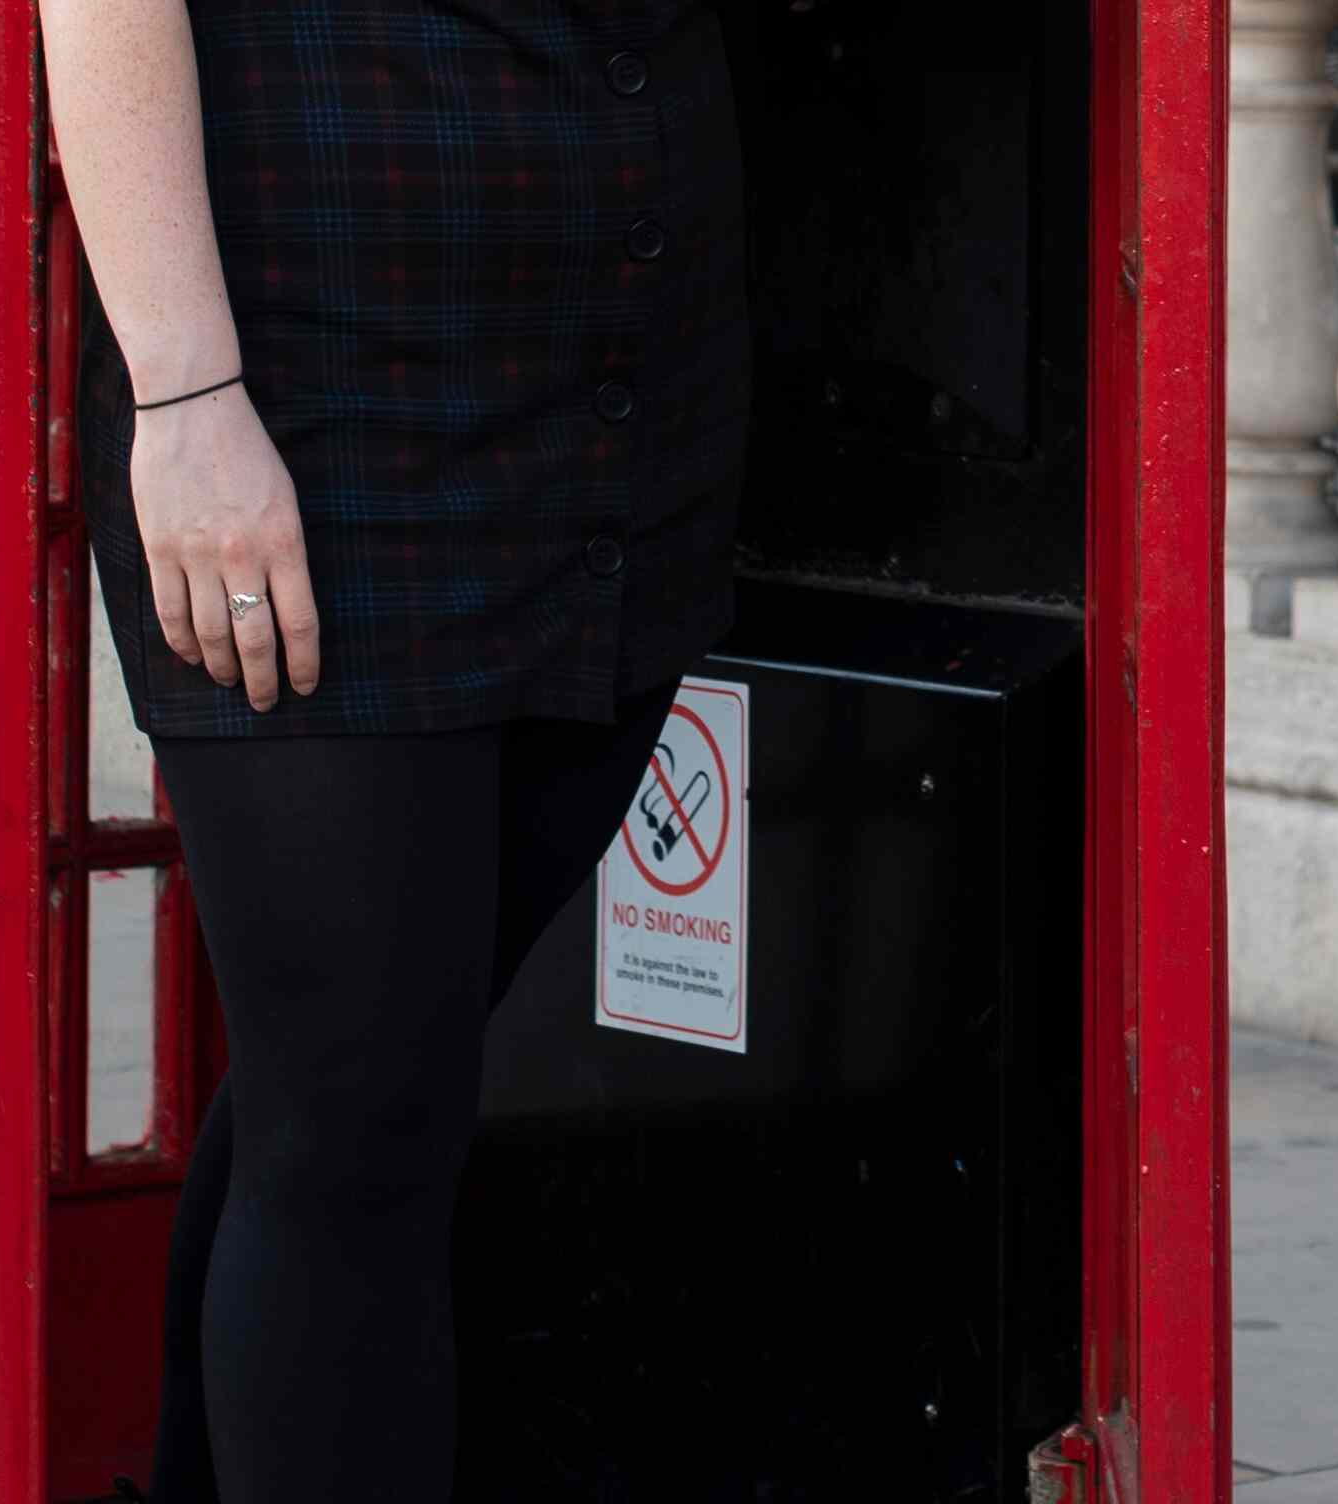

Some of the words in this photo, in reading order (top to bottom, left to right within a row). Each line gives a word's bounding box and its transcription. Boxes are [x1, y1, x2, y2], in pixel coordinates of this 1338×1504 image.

[613, 902, 639, 928] NO
[644, 907, 732, 945] SMOKING
[624, 953, 631, 965] It
[632, 955, 640, 967] is
[641, 957, 673, 973] against
[675, 963, 690, 976] the
[692, 967, 707, 979] law
[709, 969, 720, 981] to
[616, 968, 645, 983] smoke
[647, 973, 656, 985] in
[657, 975, 681, 990] these
[683, 981, 725, 999] premises.
